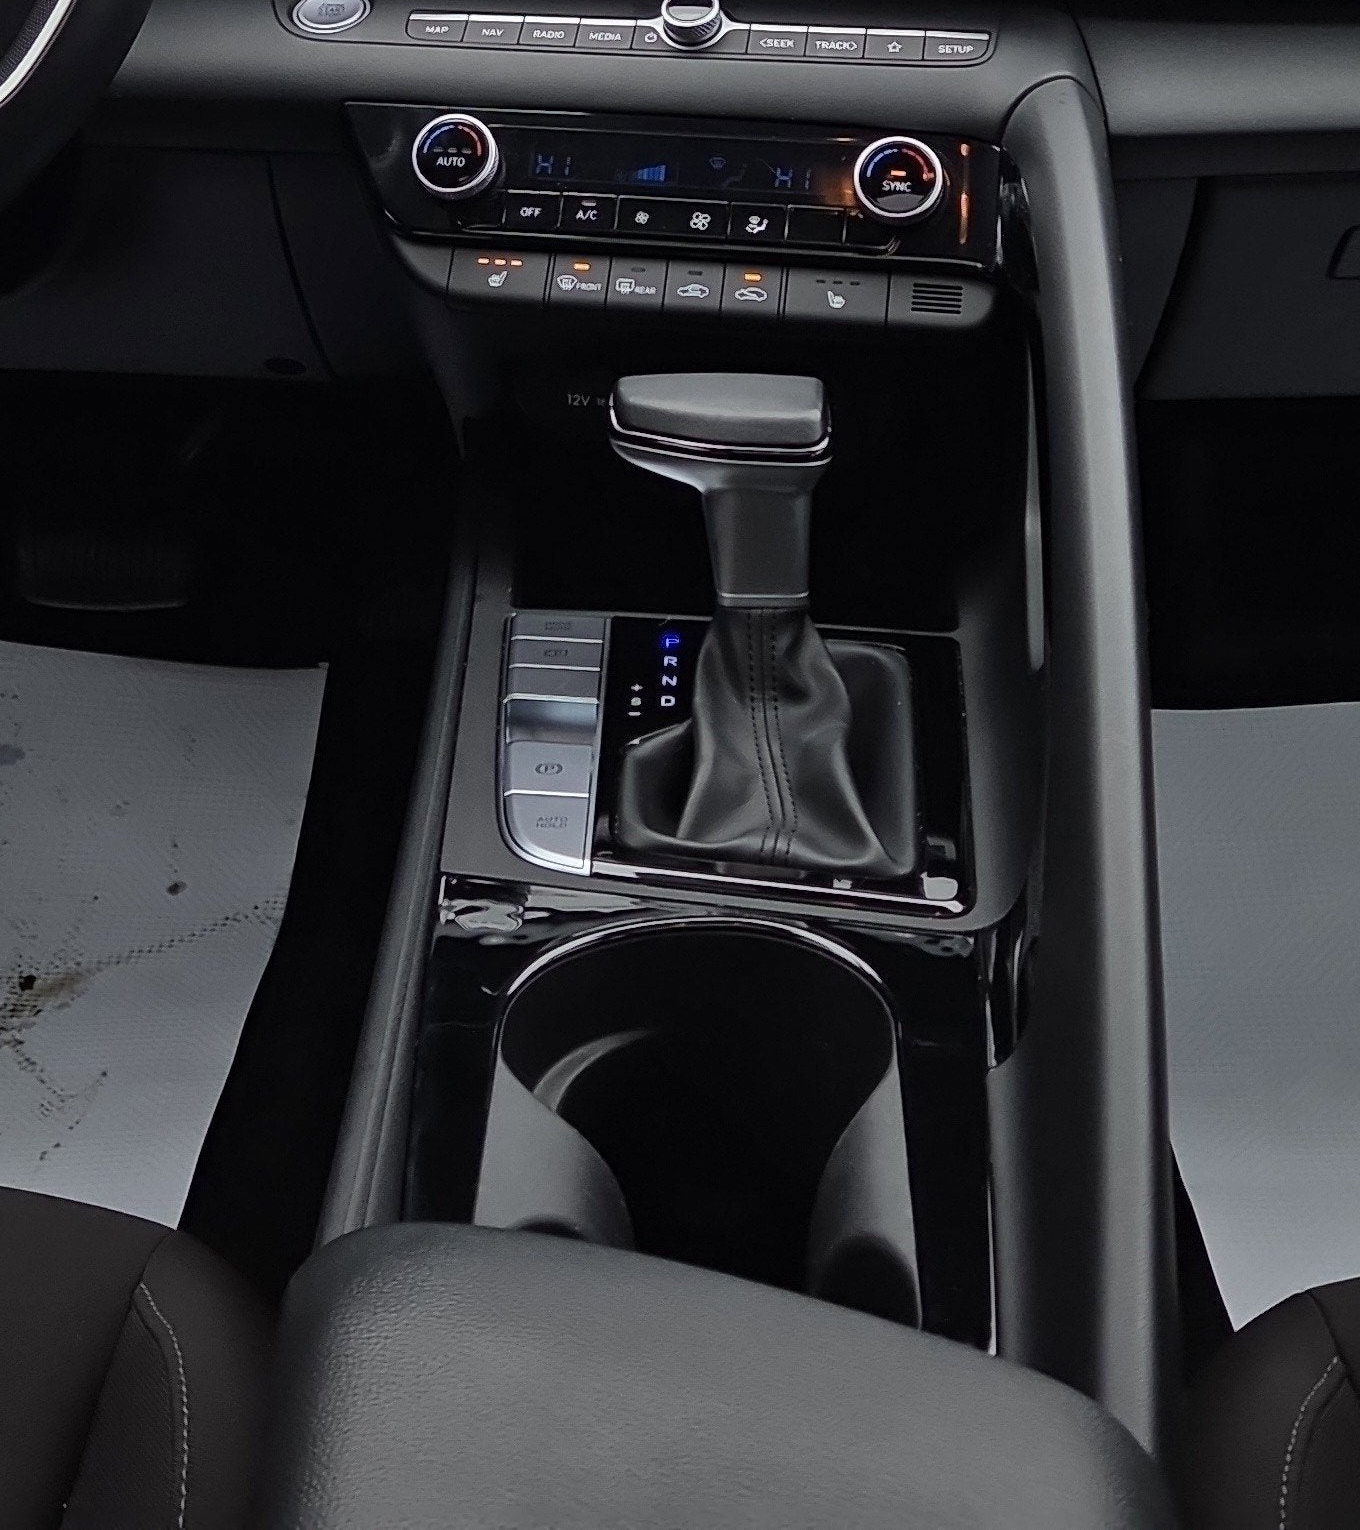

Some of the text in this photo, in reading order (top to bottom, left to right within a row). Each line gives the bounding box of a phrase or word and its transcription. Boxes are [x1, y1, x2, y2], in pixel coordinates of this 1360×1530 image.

[425, 24, 450, 35] MAP
[481, 28, 505, 38] NAV
[532, 29, 565, 40] RADIO
[589, 31, 622, 42] MEDIA
[938, 44, 974, 54] SETUP
[435, 156, 466, 168] AUTO
[881, 180, 913, 193] SYNC
[519, 206, 542, 218] OFF
[575, 209, 598, 221] A/C
[575, 281, 602, 292] FRONT
[634, 285, 657, 295] REAR
[567, 393, 590, 406] 12V
[663, 655, 678, 667] R
[661, 675, 678, 687] N
[660, 695, 676, 707] D
